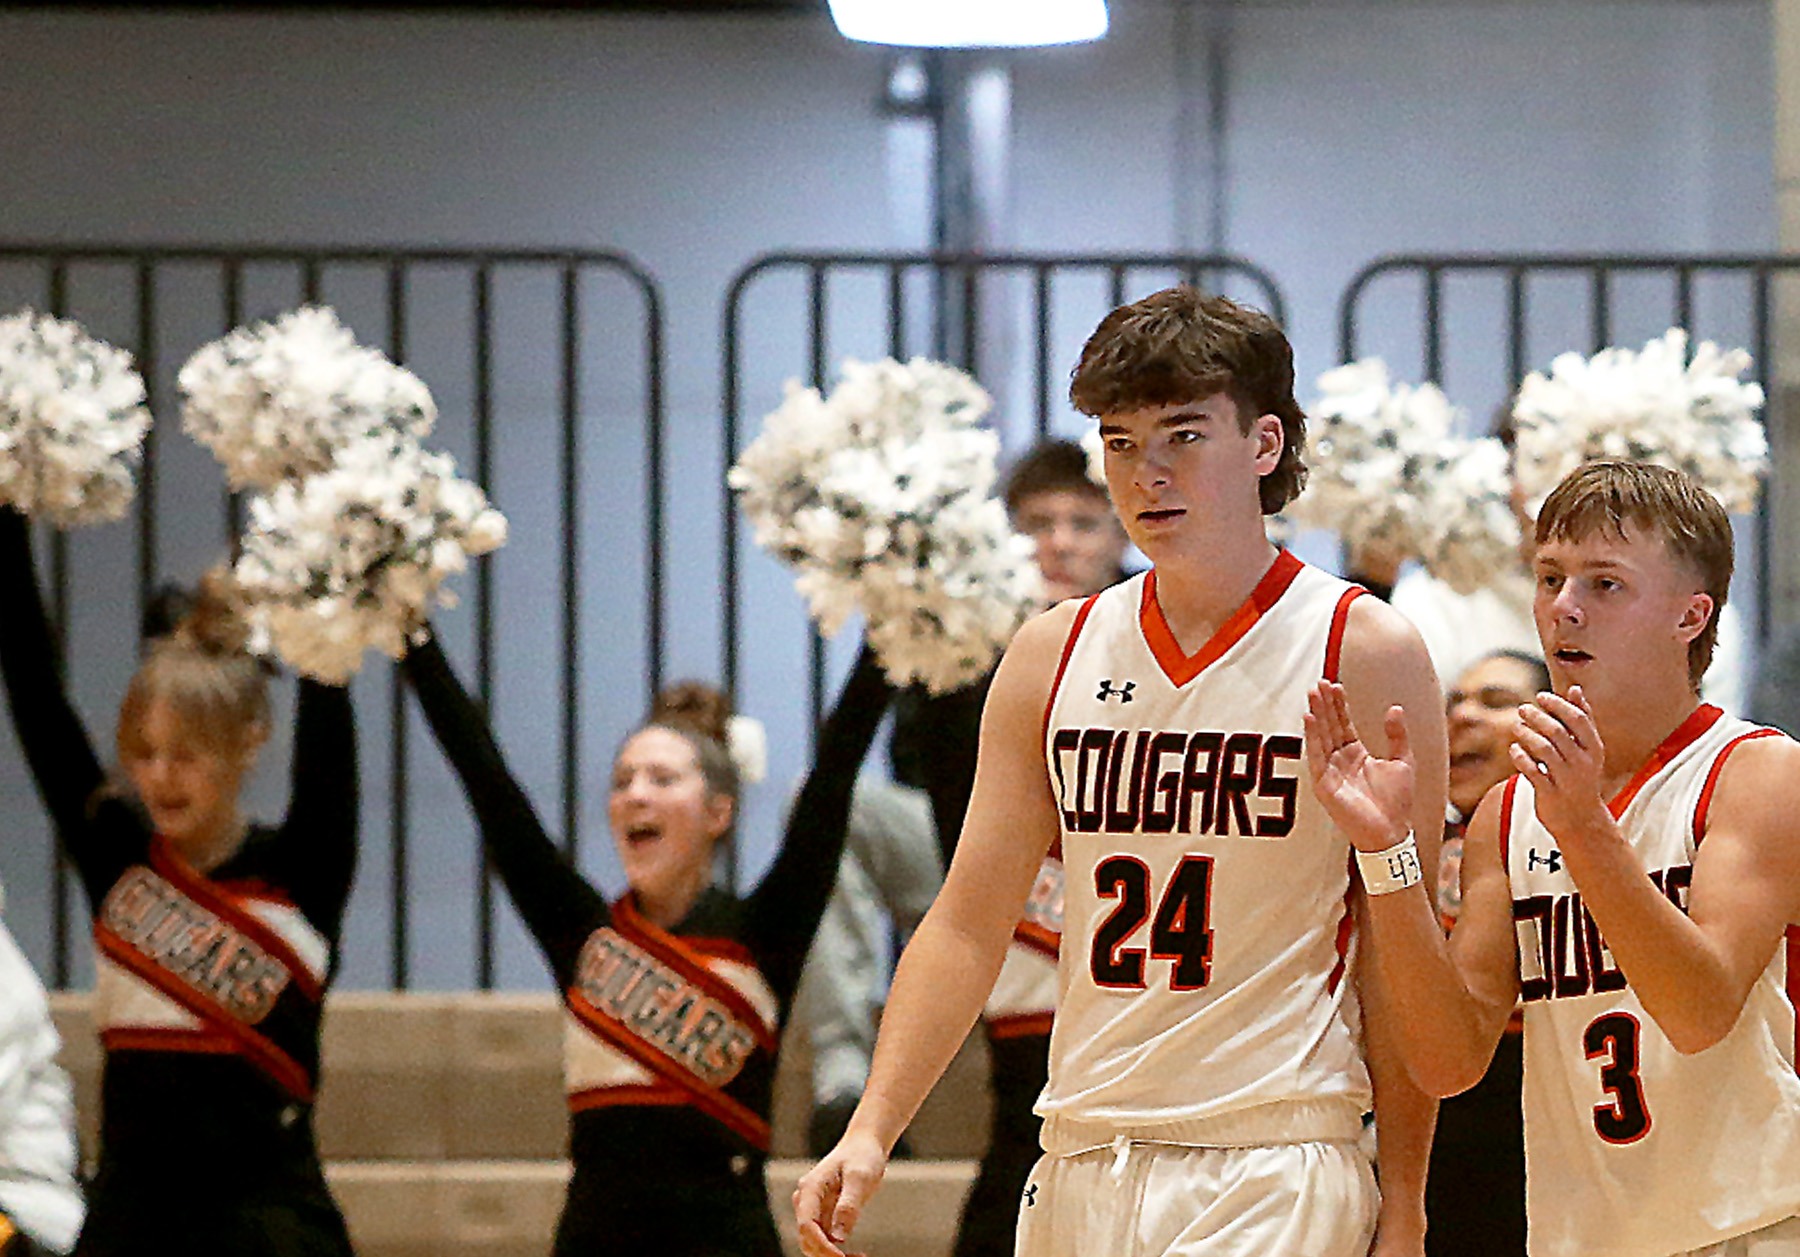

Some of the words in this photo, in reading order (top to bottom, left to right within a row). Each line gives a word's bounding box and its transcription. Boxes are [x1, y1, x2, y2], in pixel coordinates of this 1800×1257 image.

[1053, 729, 1303, 838] COUGARS
[107, 876, 290, 1010] COUGARS
[1091, 855, 1215, 991] 24
[580, 937, 755, 1075] COUGARS
[1583, 1011, 1651, 1145] 3
